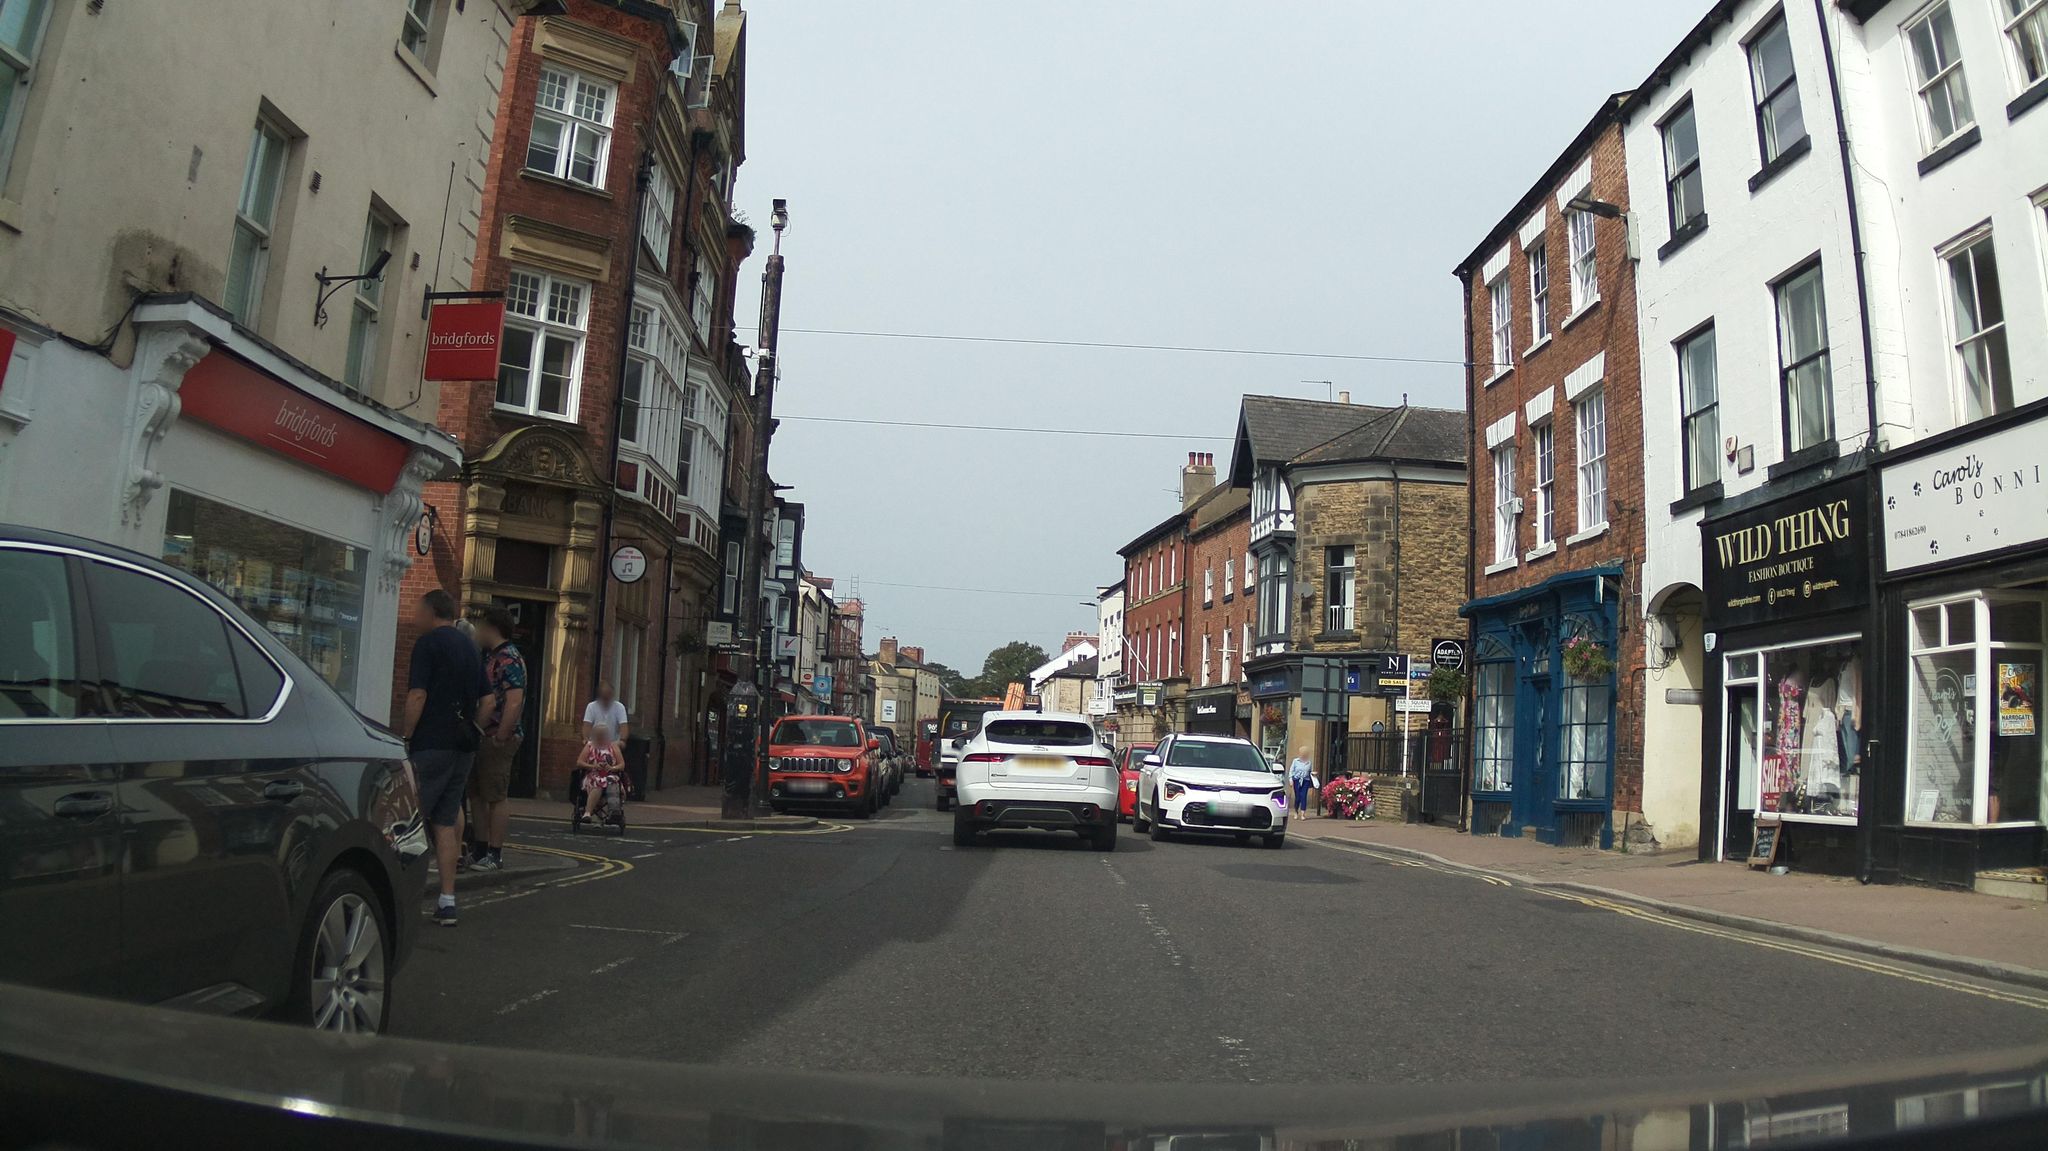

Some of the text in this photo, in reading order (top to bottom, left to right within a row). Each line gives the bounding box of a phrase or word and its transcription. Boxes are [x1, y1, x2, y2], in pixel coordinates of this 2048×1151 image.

[432, 331, 495, 348] bridgfords
[274, 399, 338, 448] bridgfords
[1932, 454, 1984, 491] Carol's
[507, 493, 556, 521] BANK
[1715, 498, 1850, 570] WILD THING
[1748, 557, 1814, 583] FASHION BOUTIQUE
[1762, 758, 1782, 794] SALE
